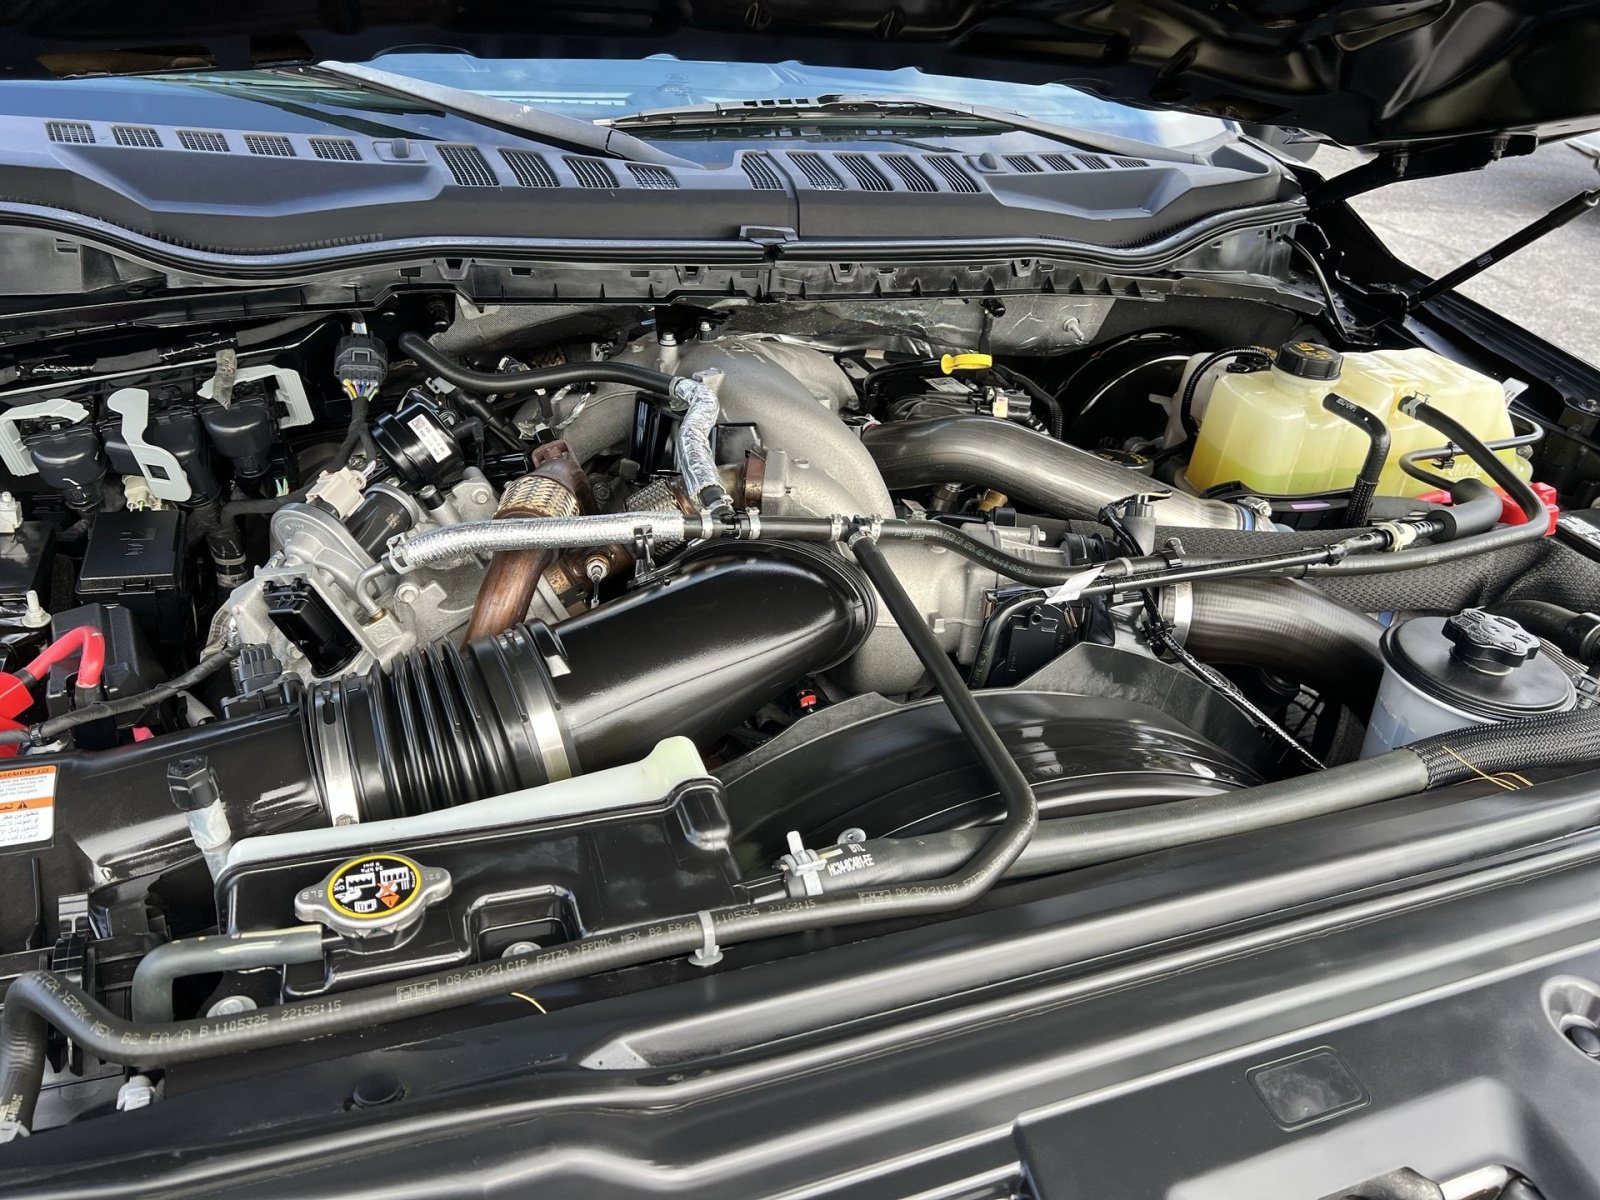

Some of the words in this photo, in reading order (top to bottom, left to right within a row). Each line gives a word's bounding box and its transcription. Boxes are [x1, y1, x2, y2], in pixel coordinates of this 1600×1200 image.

[214, 1013, 270, 1035] 1105325
[280, 999, 342, 1021] 22:52:15
[620, 931, 641, 945] MEX
